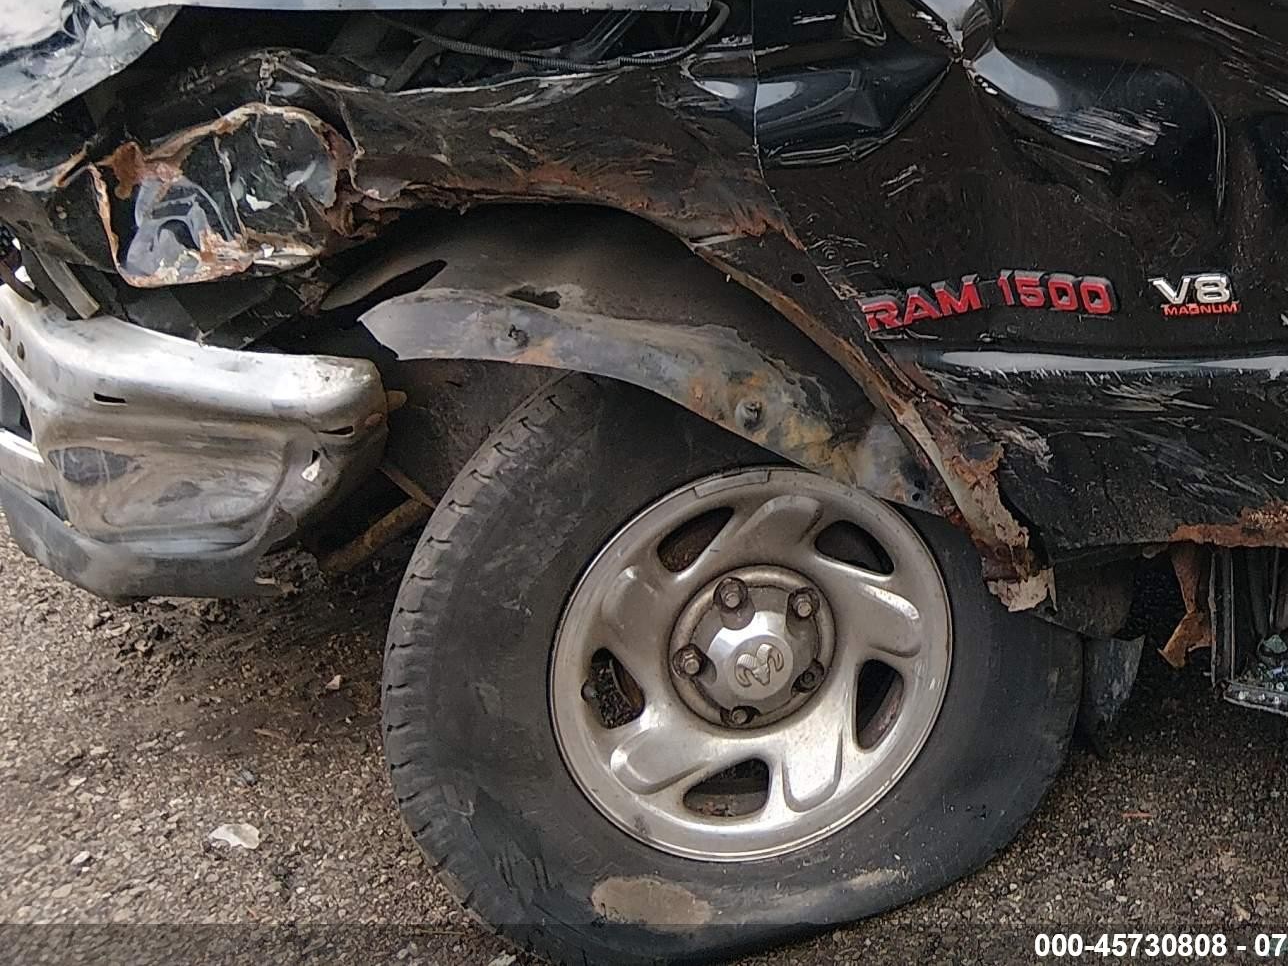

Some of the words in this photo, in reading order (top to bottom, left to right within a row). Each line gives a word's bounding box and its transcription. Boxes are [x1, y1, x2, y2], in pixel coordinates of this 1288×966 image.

[859, 275, 981, 332] RAM
[998, 269, 1117, 314] 1500
[1150, 274, 1231, 304] V8
[1163, 303, 1239, 316] MAGNUM
